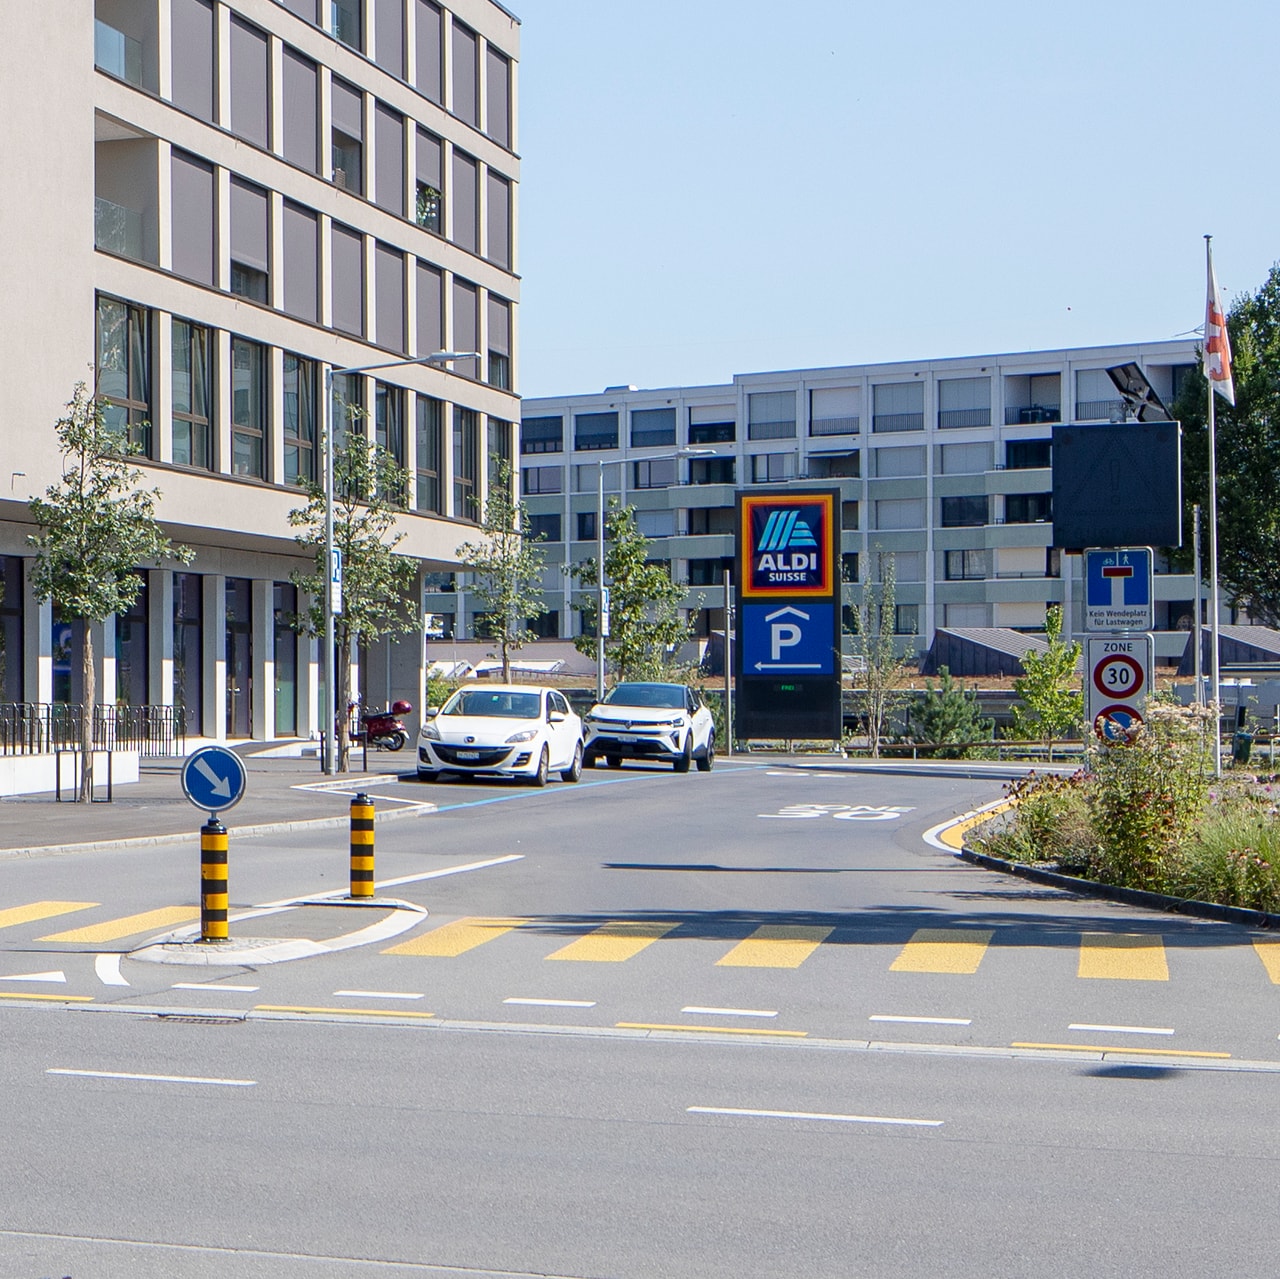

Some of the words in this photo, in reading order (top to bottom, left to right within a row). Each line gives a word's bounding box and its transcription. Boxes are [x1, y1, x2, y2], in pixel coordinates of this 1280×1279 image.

[758, 552, 817, 571] ALDI
[769, 572, 807, 582] SUISSE
[1106, 609, 1147, 618] Wendeplatz
[1106, 618, 1144, 627] Lastwagen
[771, 623, 802, 660] P
[1103, 642, 1133, 652] ZONE
[1108, 667, 1130, 685] 30
[757, 808, 901, 821] 30
